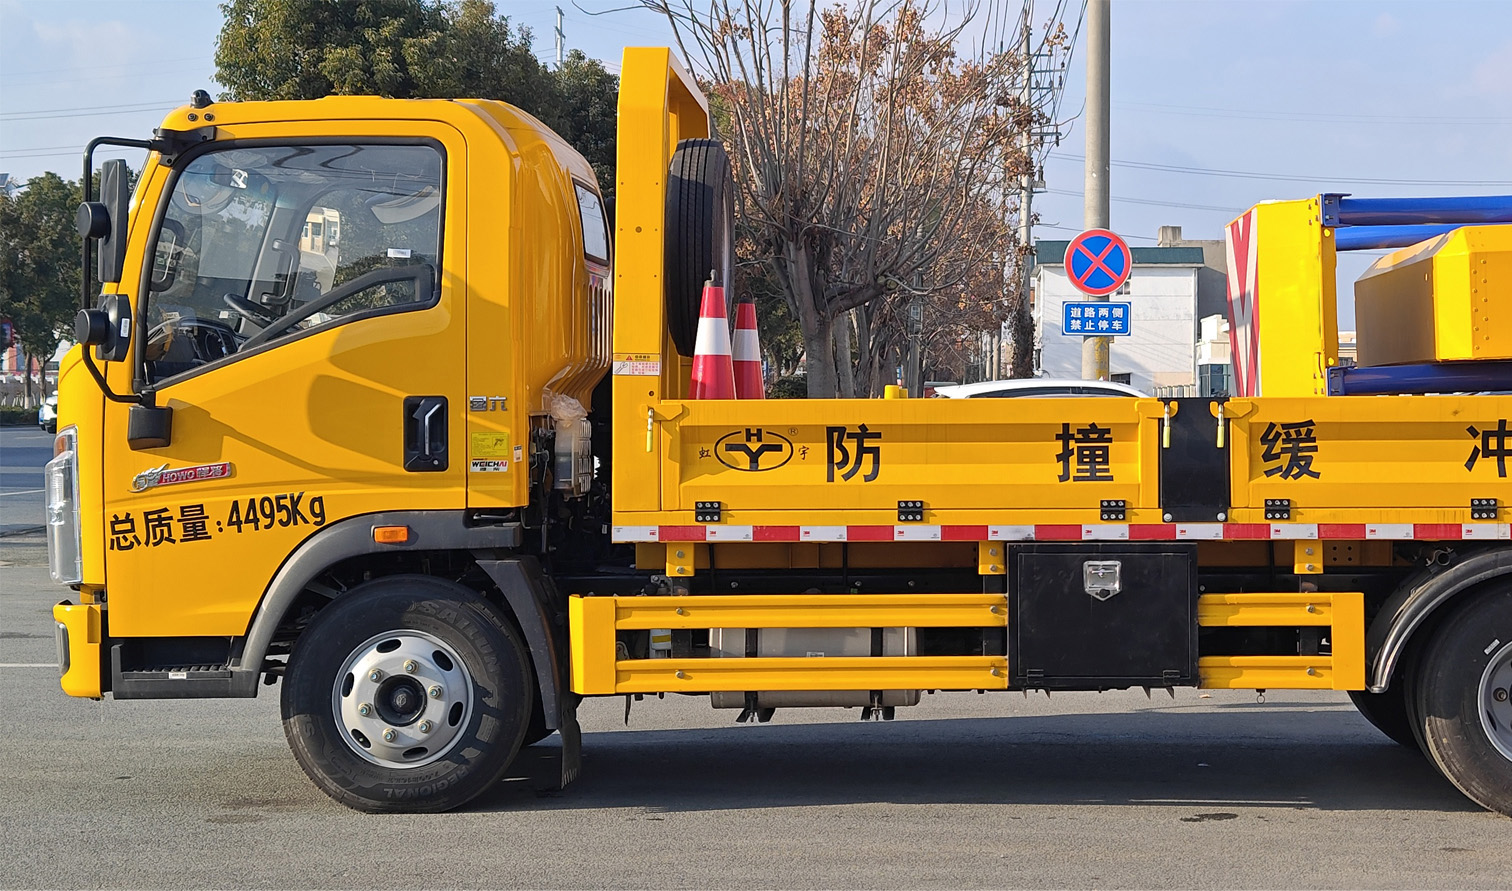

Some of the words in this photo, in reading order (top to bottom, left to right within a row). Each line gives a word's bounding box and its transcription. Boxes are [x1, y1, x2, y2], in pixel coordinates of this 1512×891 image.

[1070, 306, 1124, 318] 道路两侧
[1070, 319, 1123, 331] 禁止停车
[469, 395, 508, 411] 国六
[698, 446, 712, 460] 虹
[161, 470, 196, 483] HOWO
